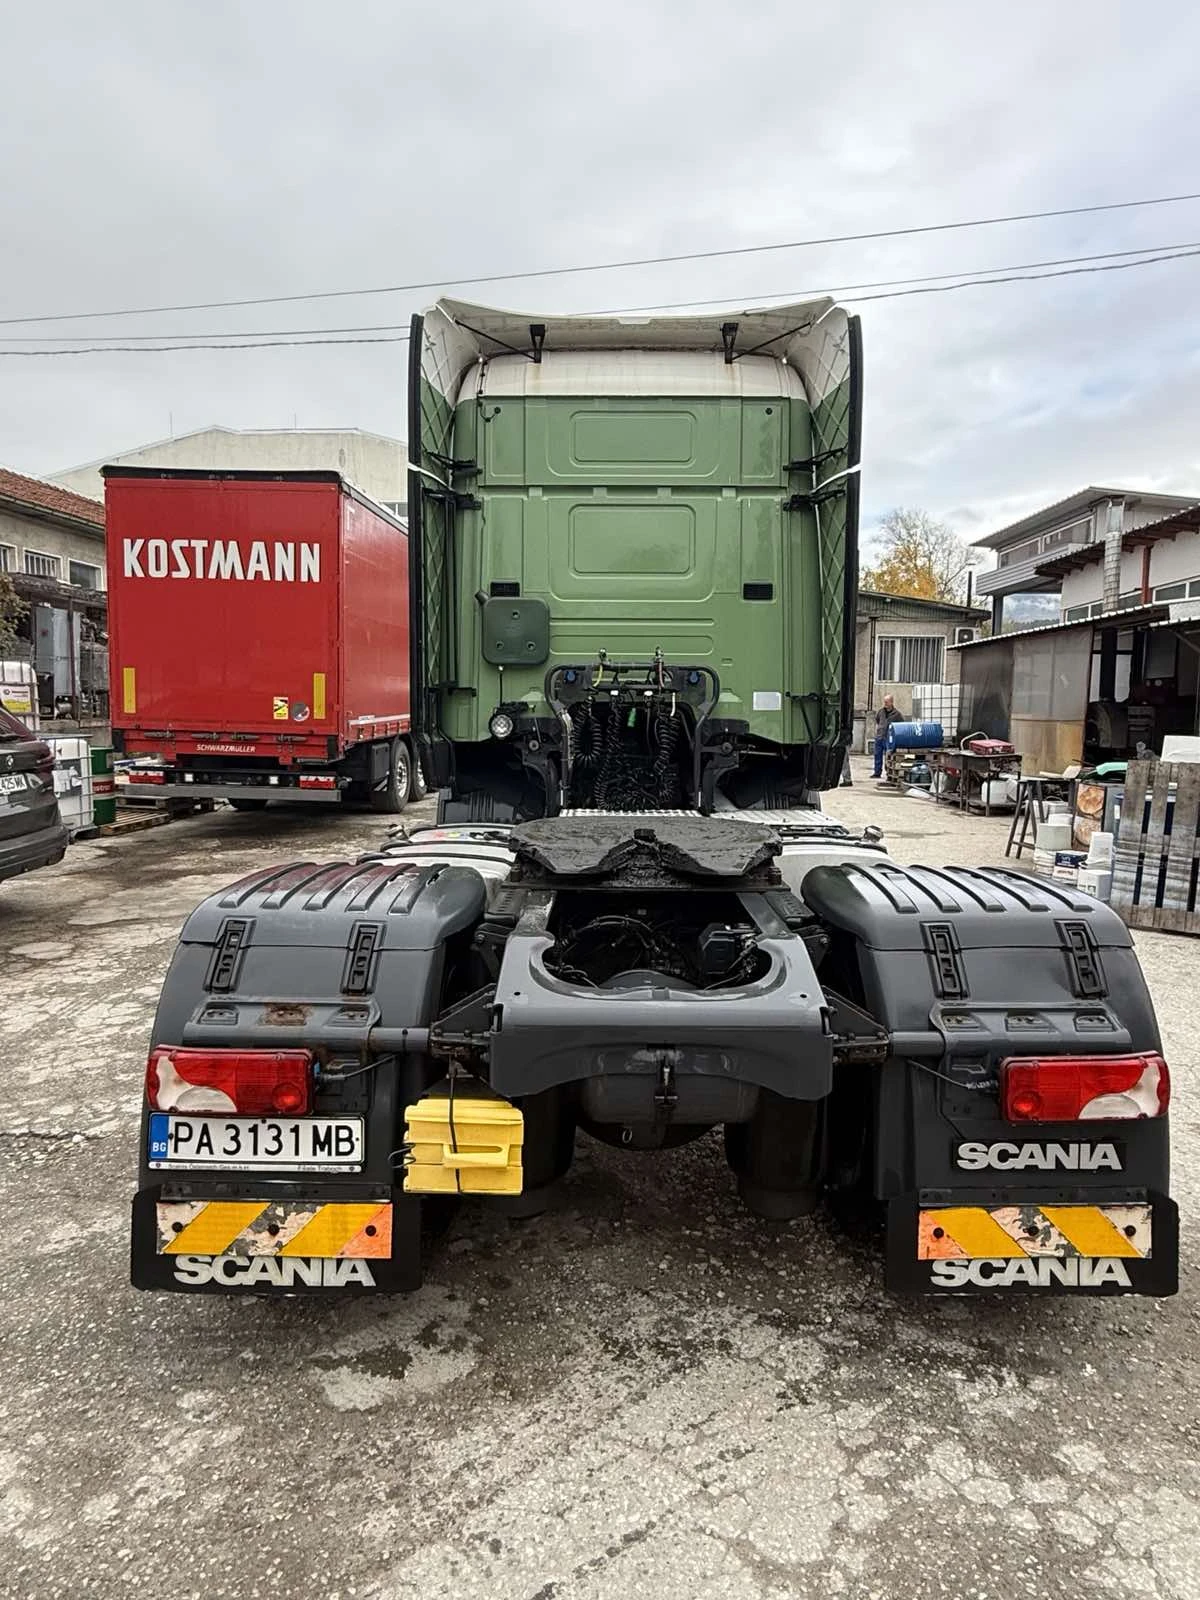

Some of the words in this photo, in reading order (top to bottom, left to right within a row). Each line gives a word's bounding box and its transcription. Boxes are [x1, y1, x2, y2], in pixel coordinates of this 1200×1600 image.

[123, 538, 320, 583] KOSTMANN
[152, 1142, 167, 1152] BG
[957, 1142, 1123, 1170] SCANIA
[173, 1254, 377, 1287] SCANIA
[930, 1257, 1133, 1287] SCANIA
